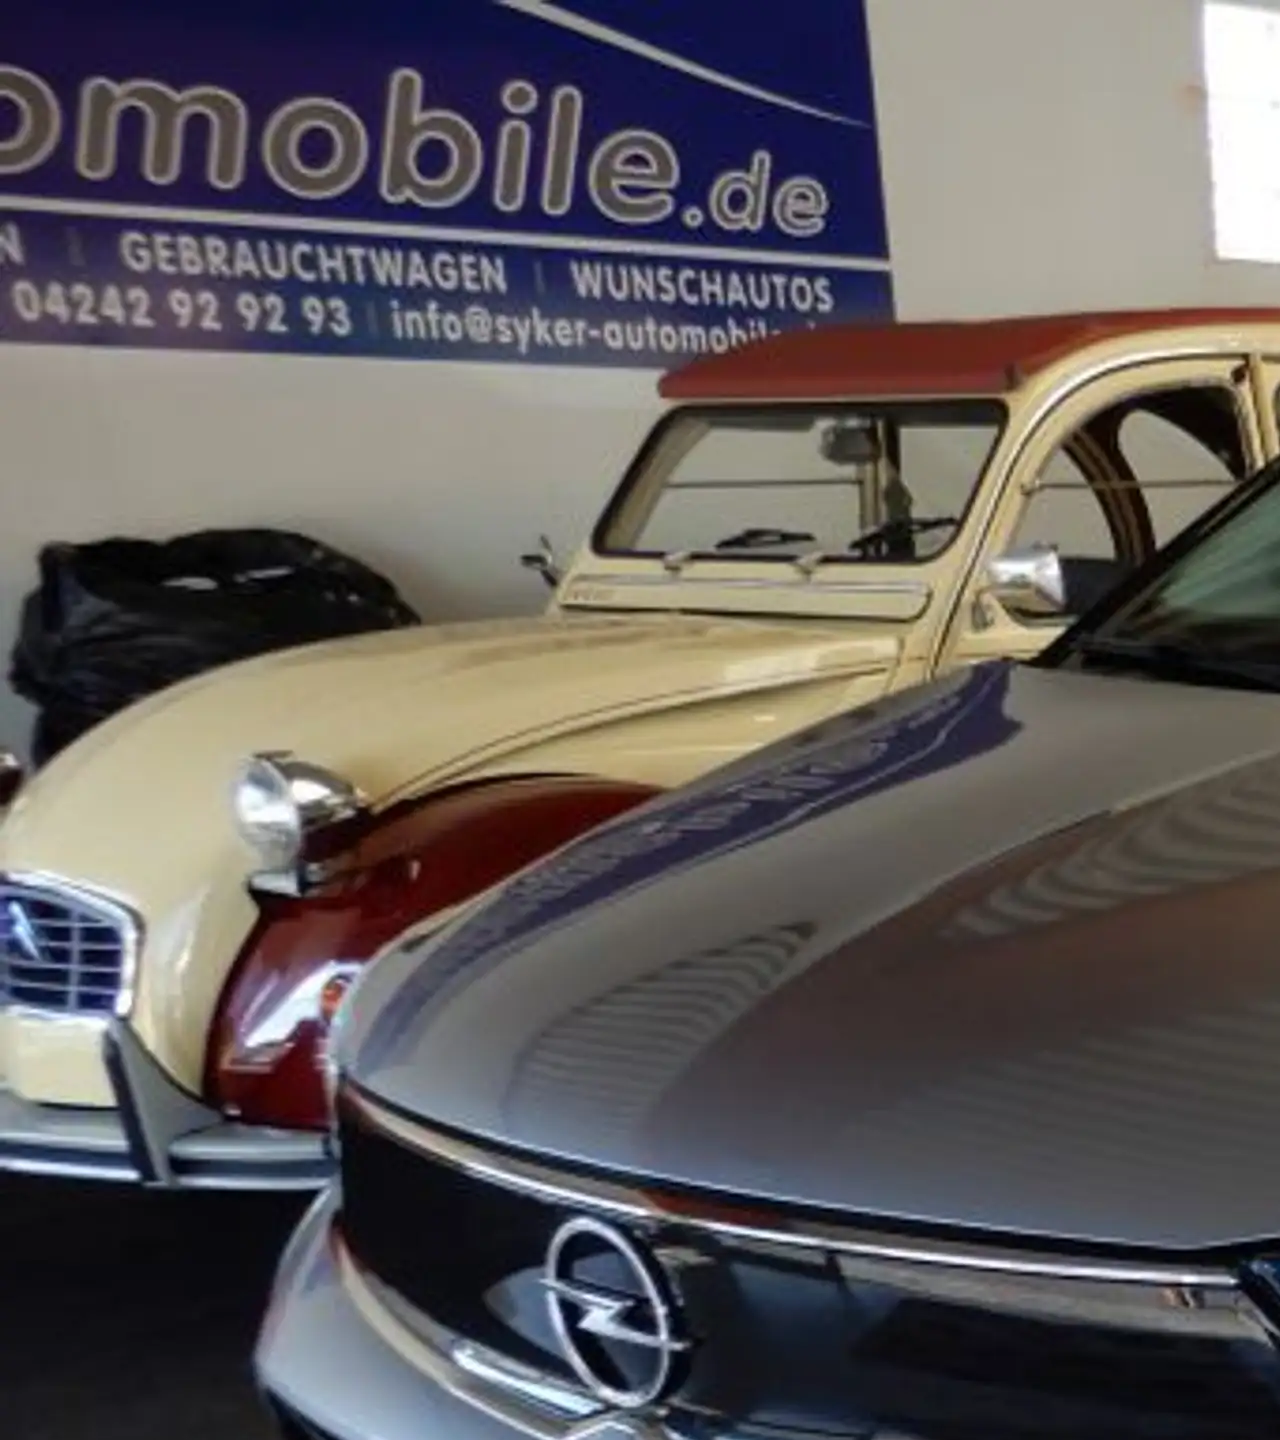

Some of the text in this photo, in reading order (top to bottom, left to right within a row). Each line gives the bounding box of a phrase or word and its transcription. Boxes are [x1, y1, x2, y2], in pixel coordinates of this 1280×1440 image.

[0, 65, 829, 237] omobile.de
[12, 280, 155, 328] 04242
[168, 287, 222, 331] 92
[236, 292, 289, 333] 92
[302, 294, 352, 336] 93
[119, 230, 507, 293] GEBRAUCHTWAGEN
[570, 260, 835, 313] WUNSCHAUTOS
